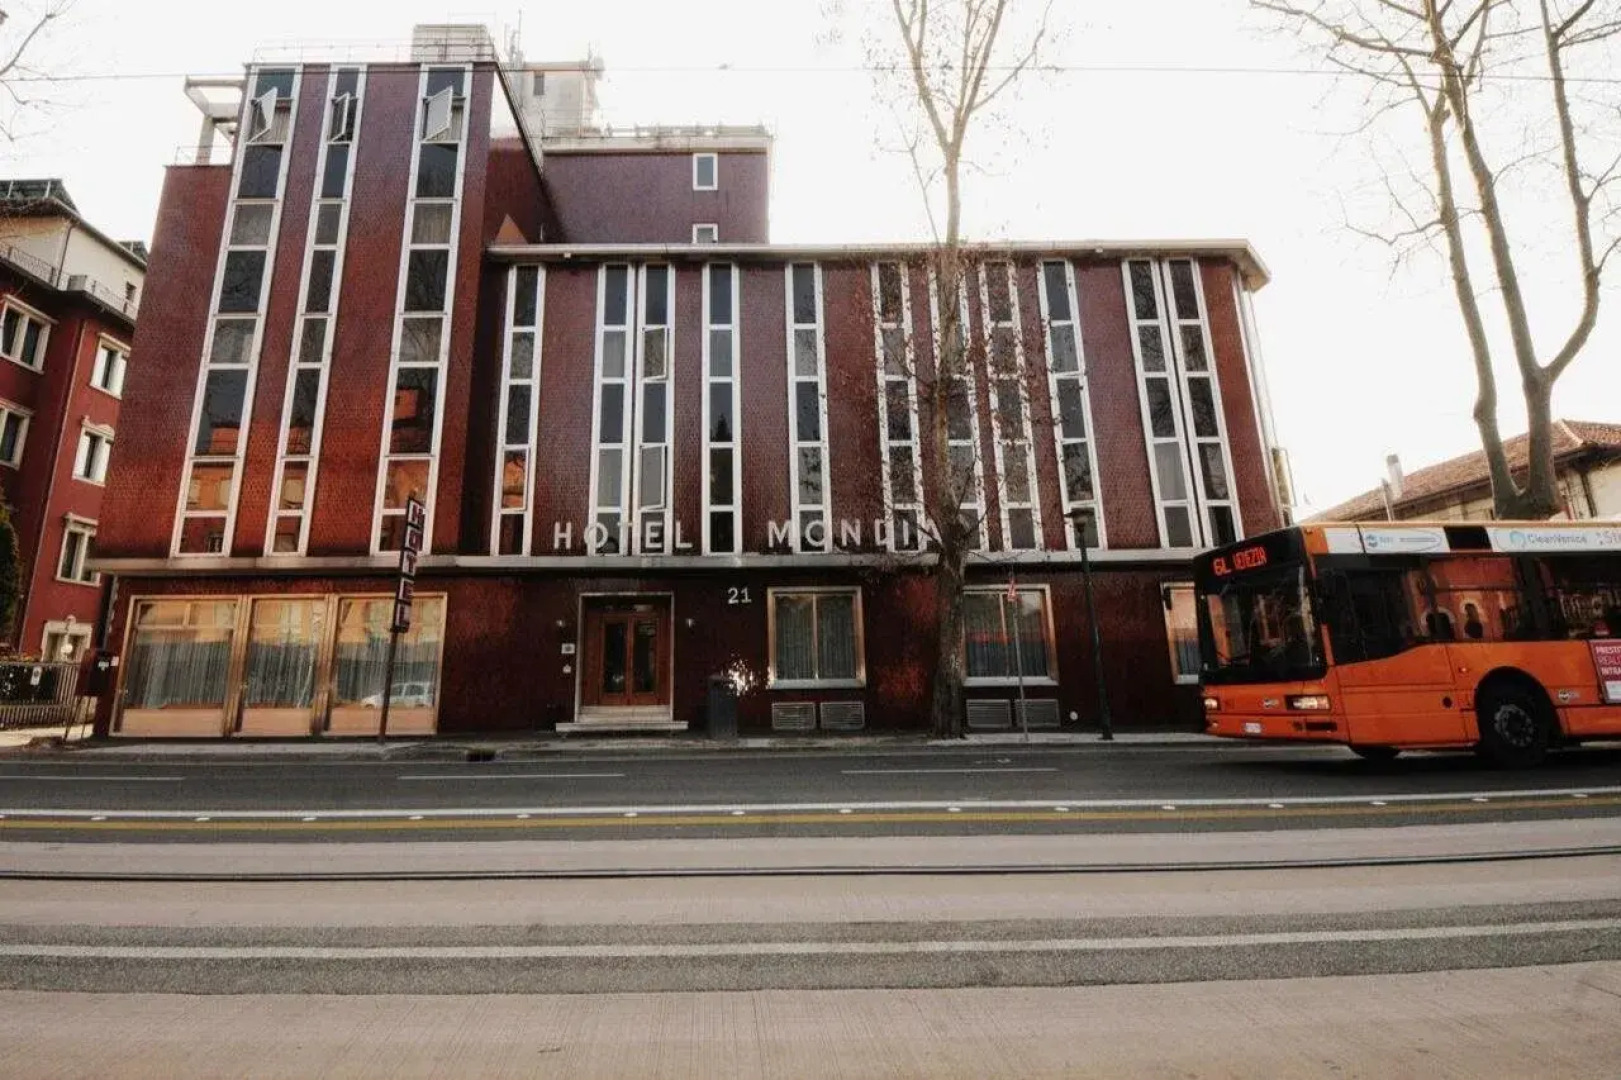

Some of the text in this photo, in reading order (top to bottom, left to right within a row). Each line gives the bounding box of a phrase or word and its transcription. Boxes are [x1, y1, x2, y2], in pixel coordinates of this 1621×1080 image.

[553, 519, 943, 550] HOTEL MONDIA
[395, 501, 425, 628] HOTEL
[728, 586, 752, 605] 21
